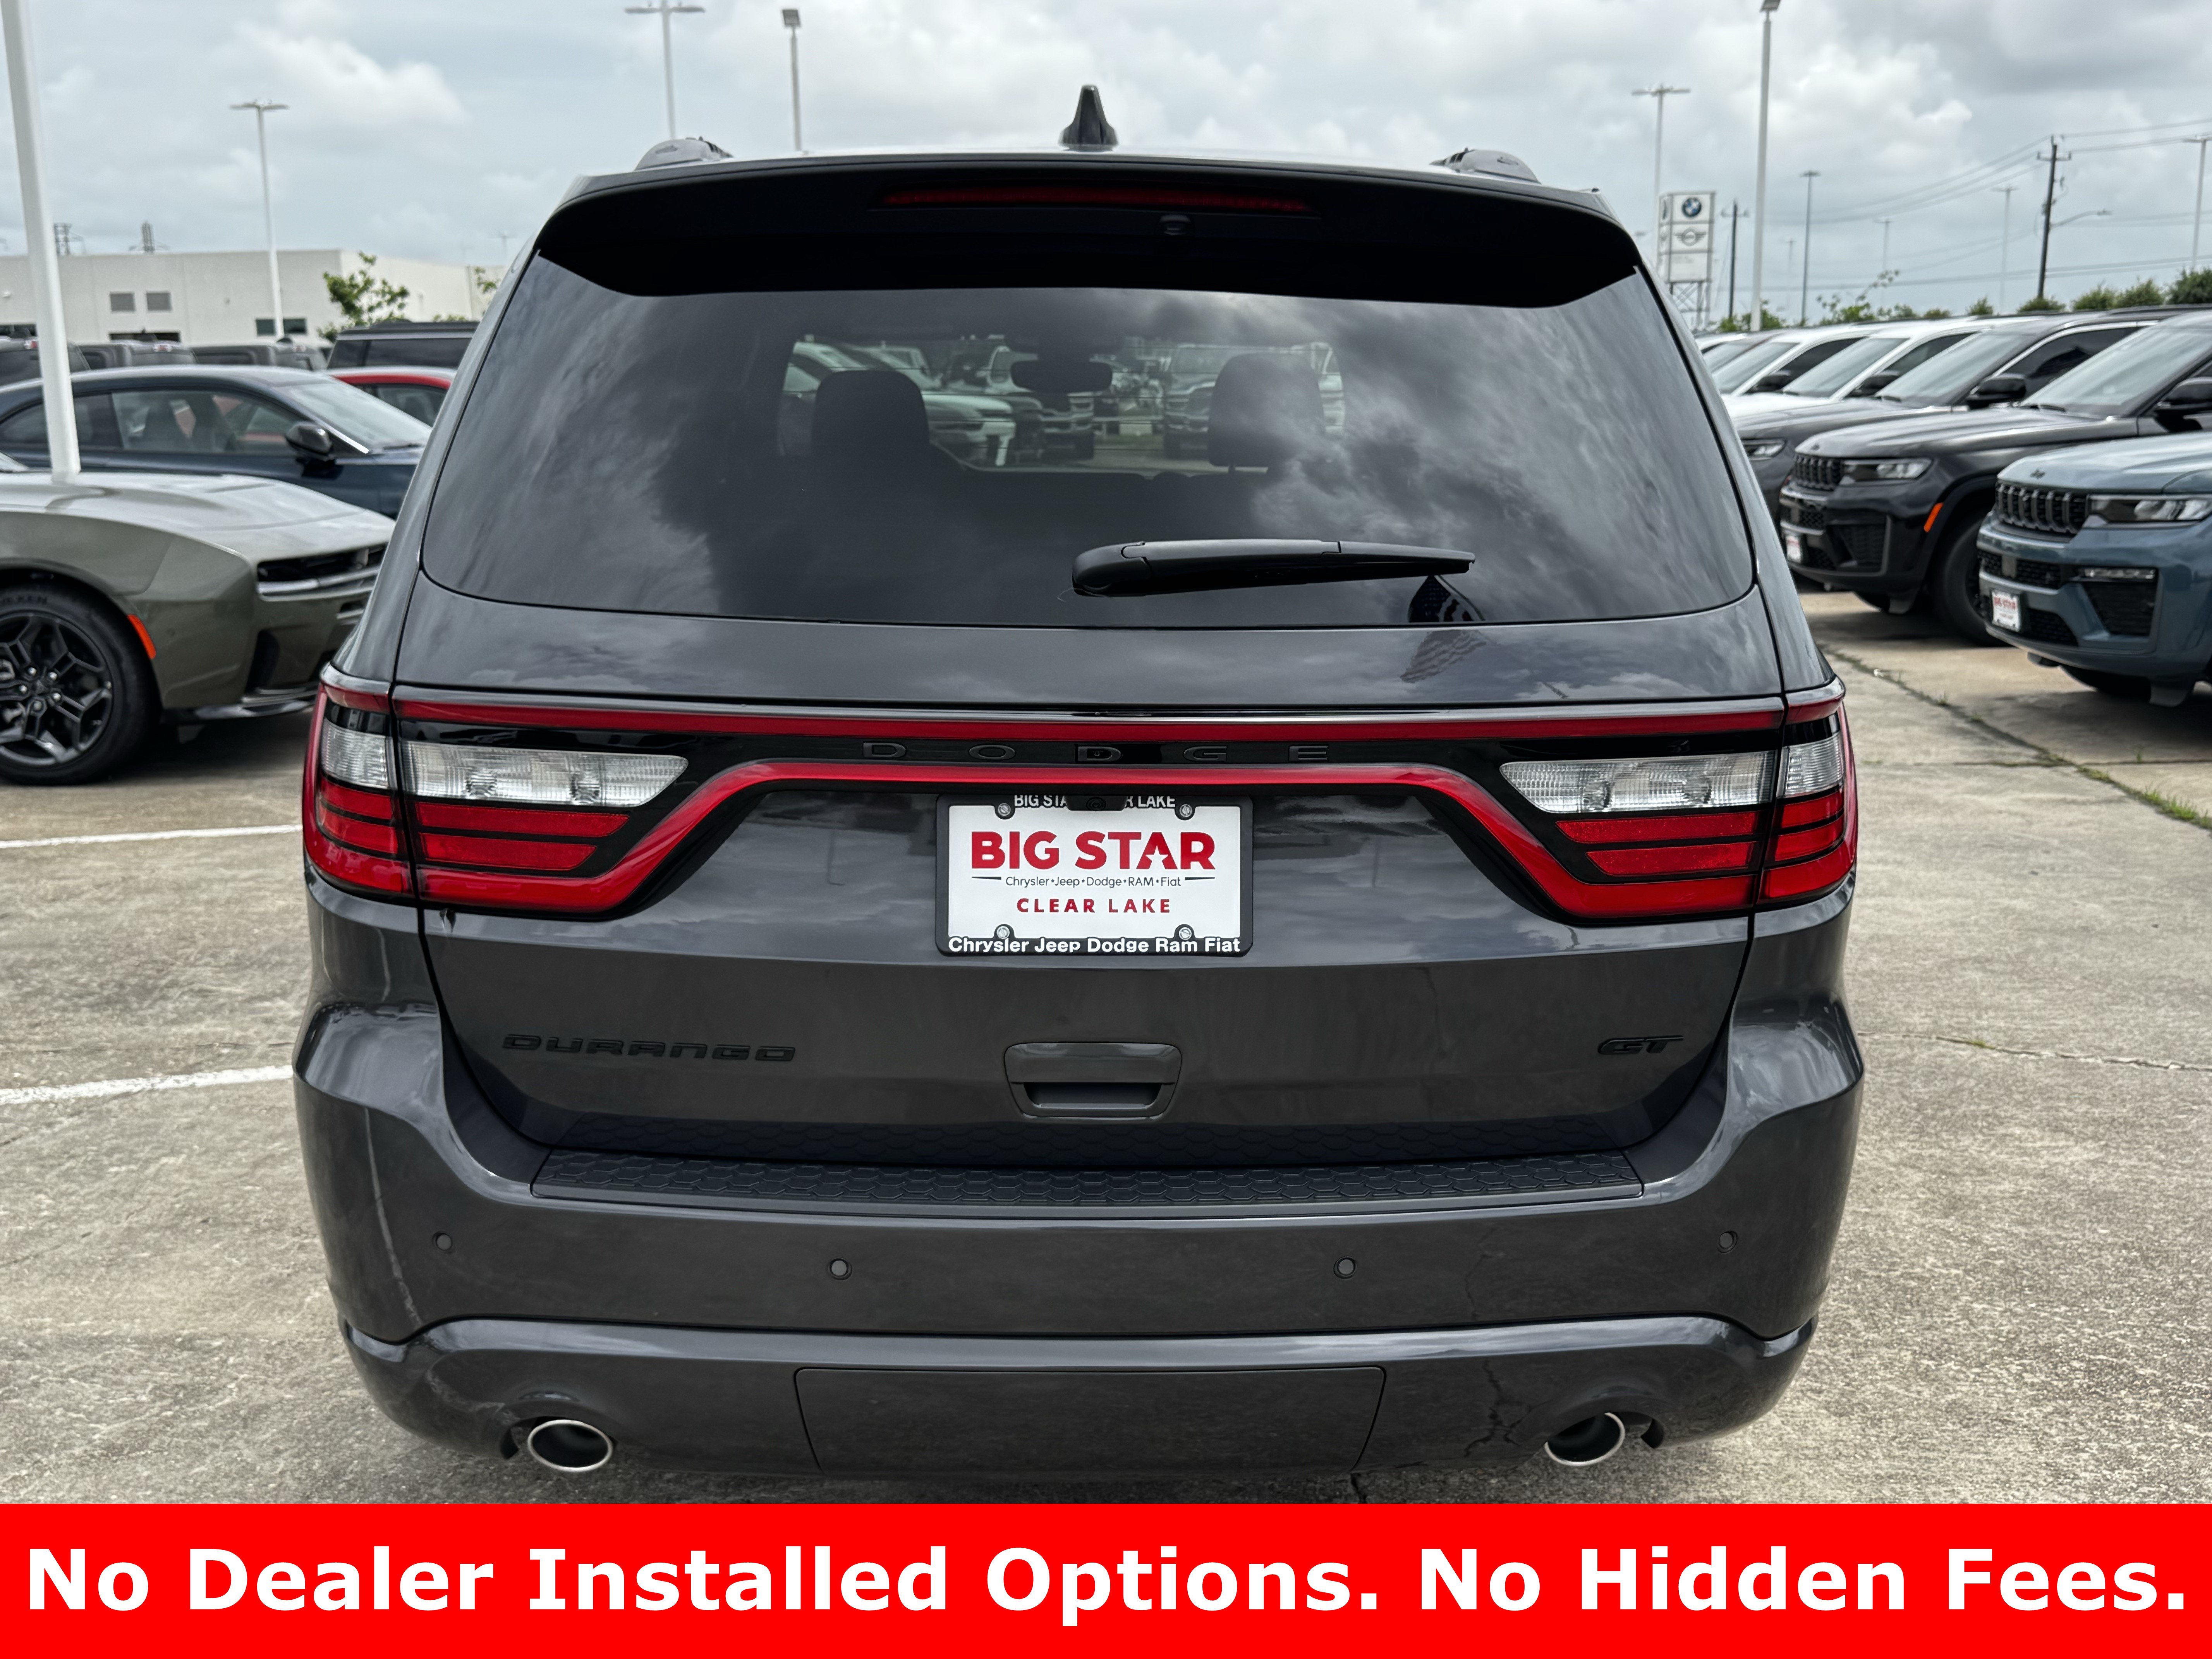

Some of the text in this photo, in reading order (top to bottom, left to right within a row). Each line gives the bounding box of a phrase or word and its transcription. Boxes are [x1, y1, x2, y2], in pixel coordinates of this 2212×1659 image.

[862, 740, 1329, 763] DODGE
[1014, 795, 1039, 807] BIG
[1043, 795, 1067, 807] STA
[1138, 796, 1176, 807] LAKE
[971, 831, 1215, 870] BIG STAR
[1017, 898, 1170, 913] CLEAR LAKE
[948, 937, 1240, 953] Chrysler Jeep Dodge Ram Fiat
[502, 1034, 796, 1061] DURANGO
[1597, 1035, 1684, 1054] GT
